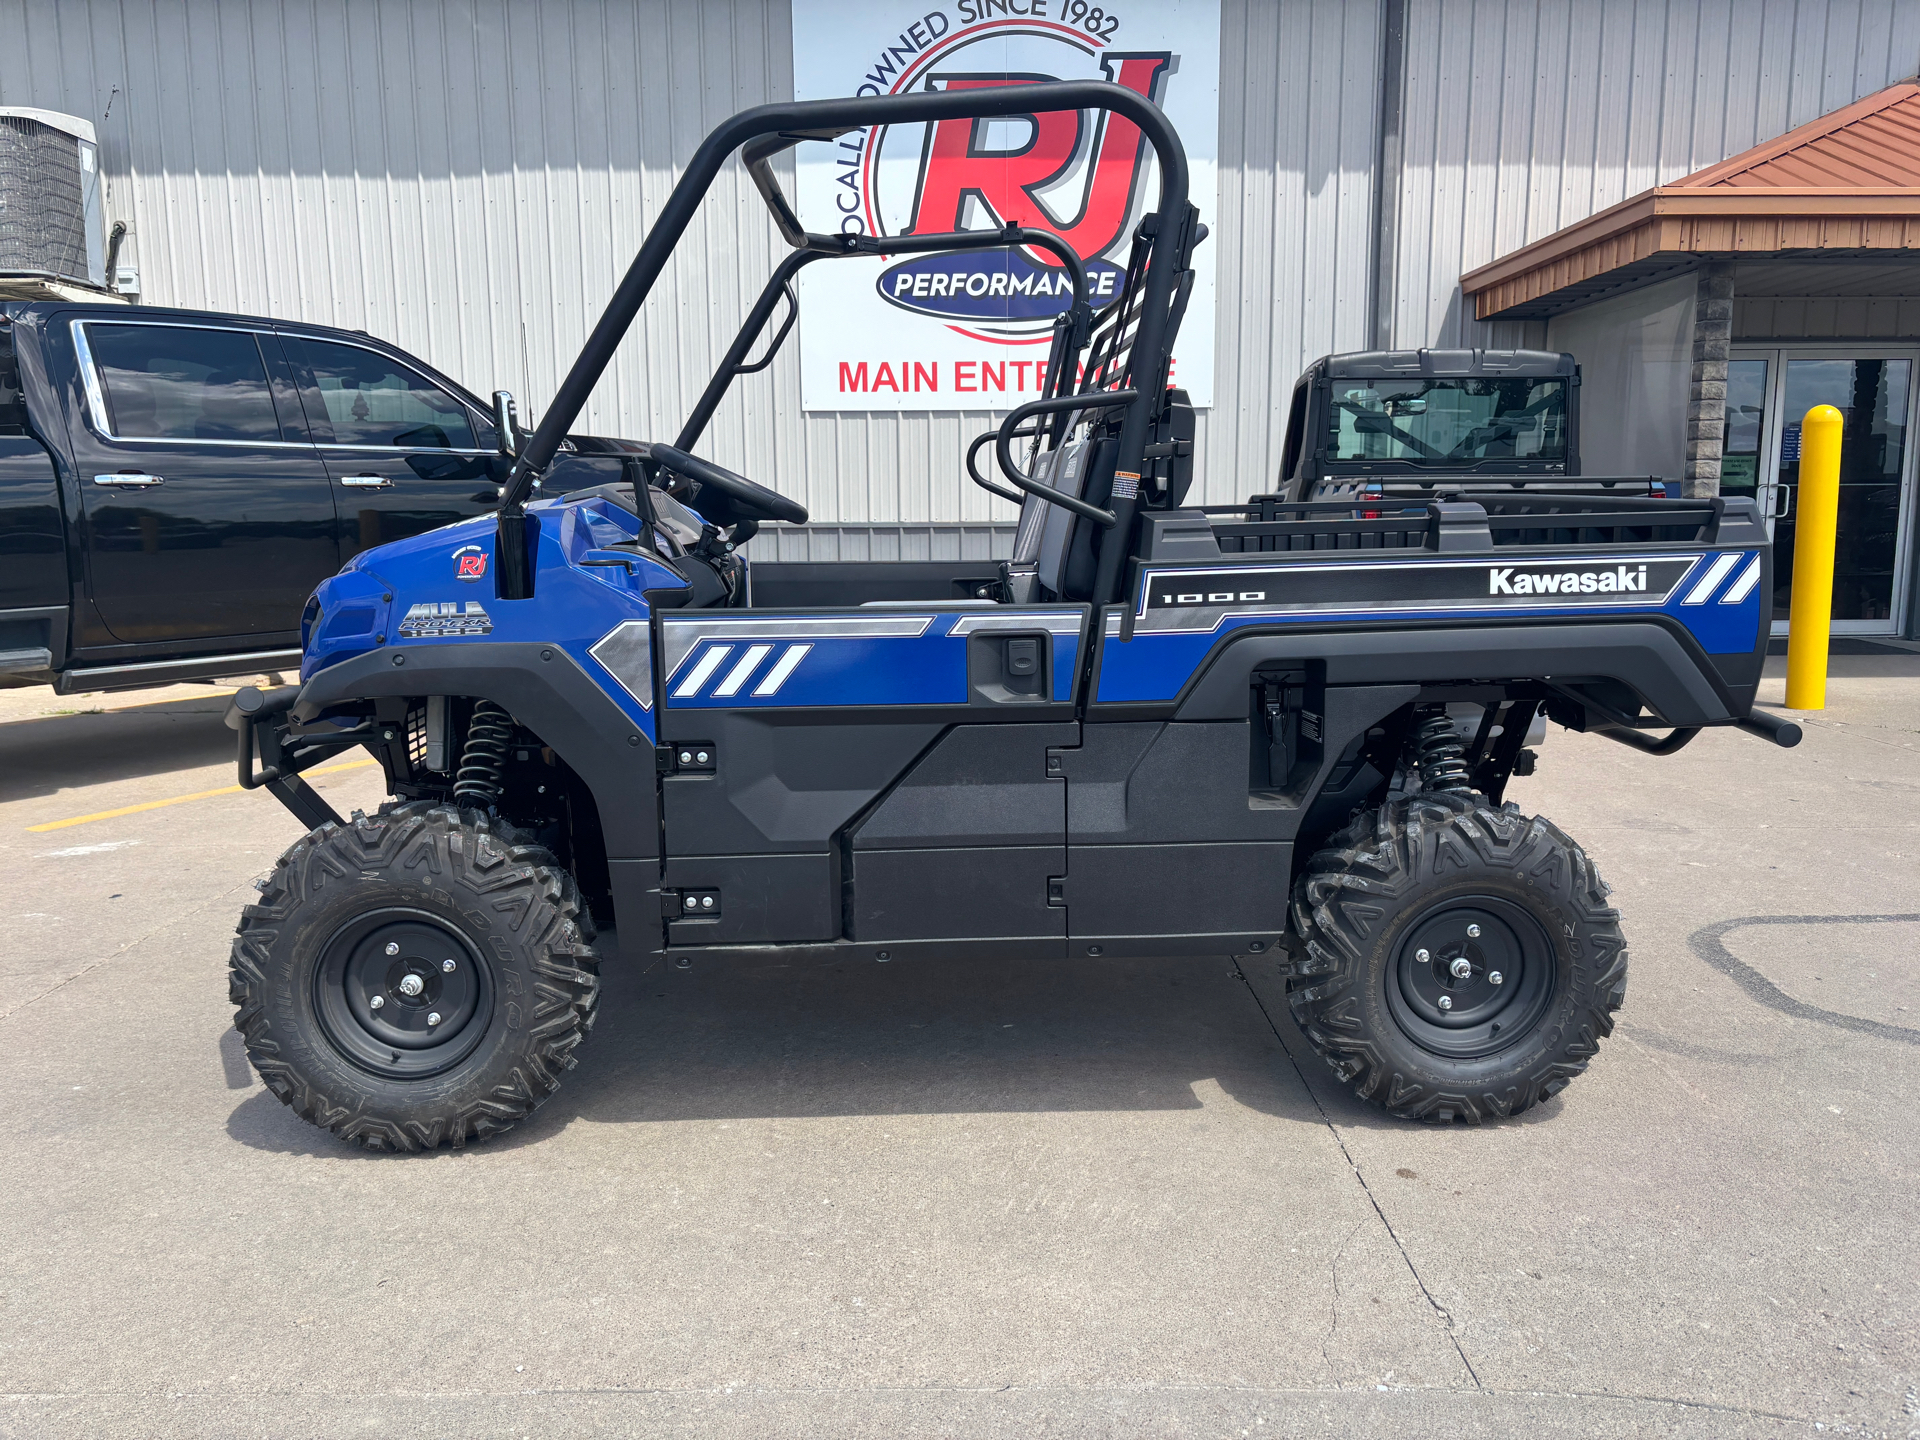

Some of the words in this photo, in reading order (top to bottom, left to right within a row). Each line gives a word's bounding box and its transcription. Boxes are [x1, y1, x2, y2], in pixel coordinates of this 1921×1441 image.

[836, 126, 867, 236] OCALL
[957, 0, 1047, 25] SINCE
[1060, 0, 1119, 43] 1982
[900, 51, 1181, 268] RJ
[894, 272, 1116, 297] PERFORMANCE
[838, 361, 938, 393] MAIN
[954, 359, 1177, 392] ENTR
[458, 553, 489, 575] RJ
[1489, 565, 1647, 595] Kawasaki
[1162, 591, 1266, 604] 1000
[402, 601, 490, 621] MULE
[409, 627, 483, 638] 1000
